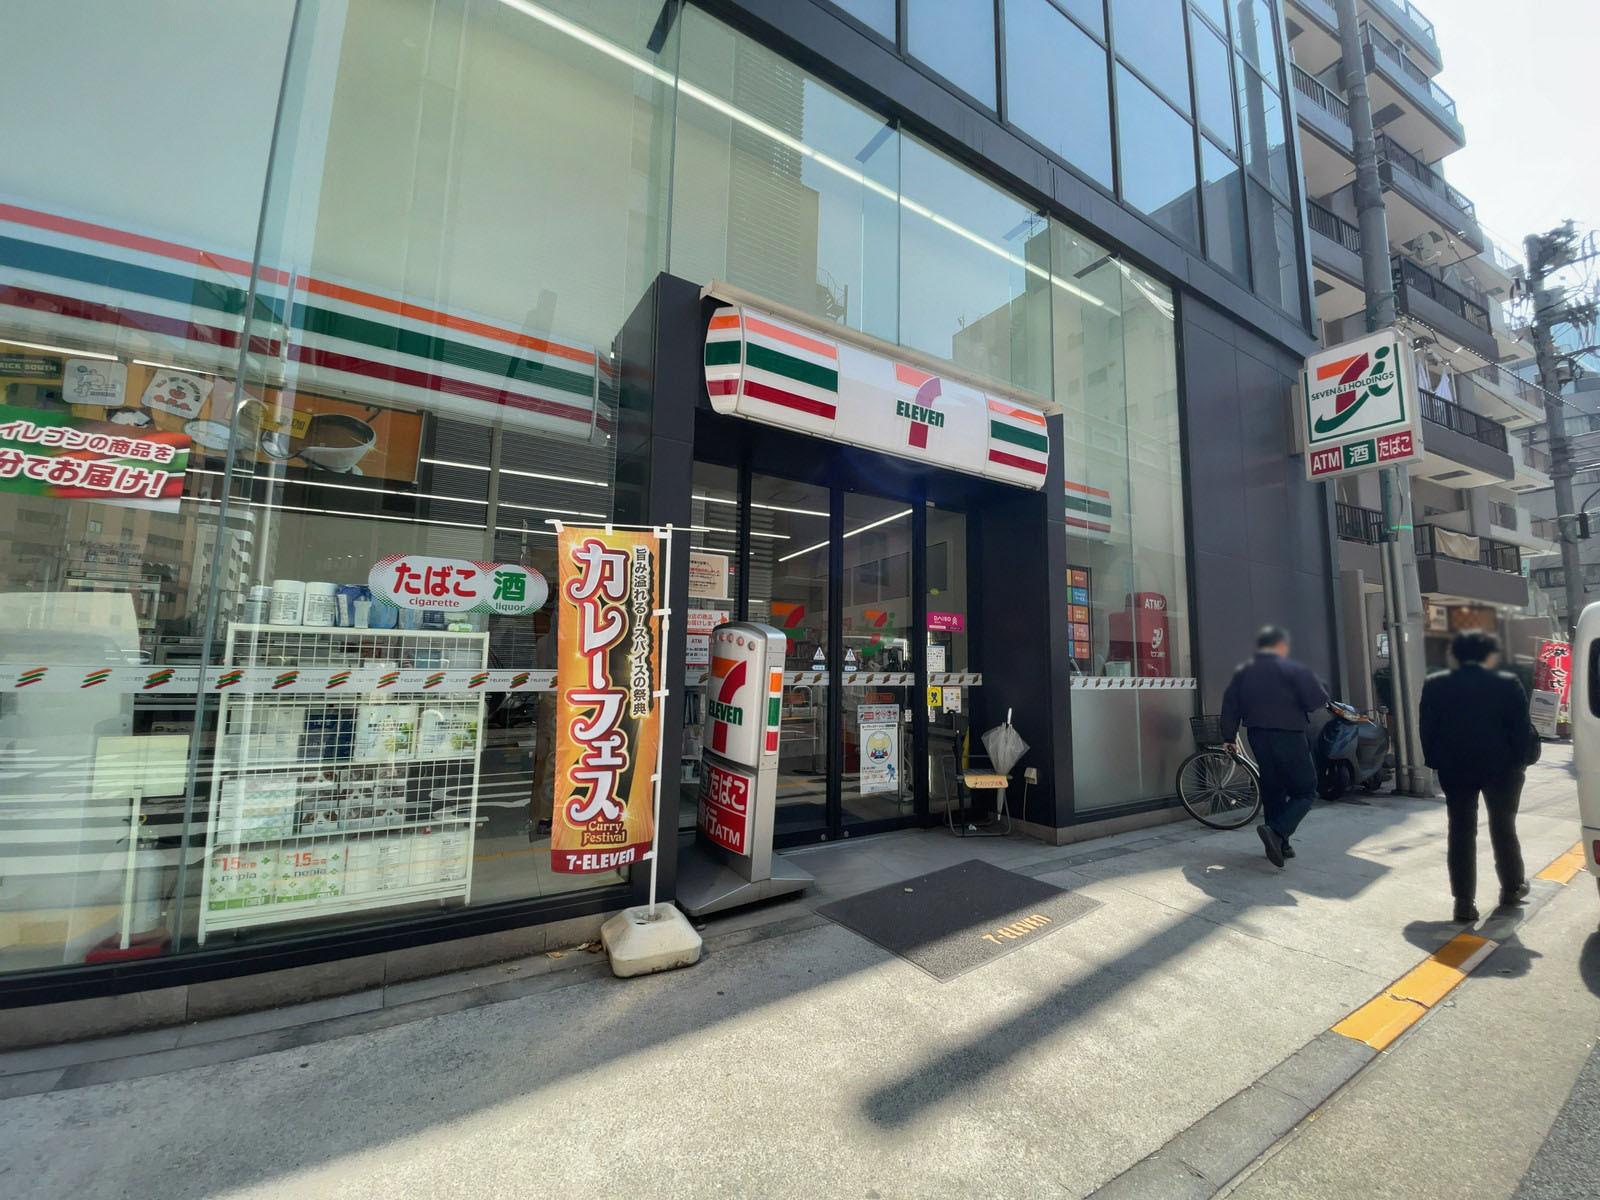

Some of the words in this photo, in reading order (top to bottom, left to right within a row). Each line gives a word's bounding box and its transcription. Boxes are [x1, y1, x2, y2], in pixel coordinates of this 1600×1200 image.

[1311, 384, 1348, 401] SEVEN&i
[1348, 371, 1395, 392] HOLDINGS
[1313, 451, 1341, 472] ATM
[1349, 443, 1369, 465] 酒
[1378, 436, 1411, 457] たばこ
[393, 562, 477, 598] たばこ
[492, 570, 527, 601] 酒
[409, 597, 460, 608] cigarette
[495, 602, 526, 612] liquor
[1145, 598, 1160, 609] ATM
[569, 543, 627, 822] カレーフェス
[583, 831, 626, 844] Festival
[588, 821, 623, 833] Curry
